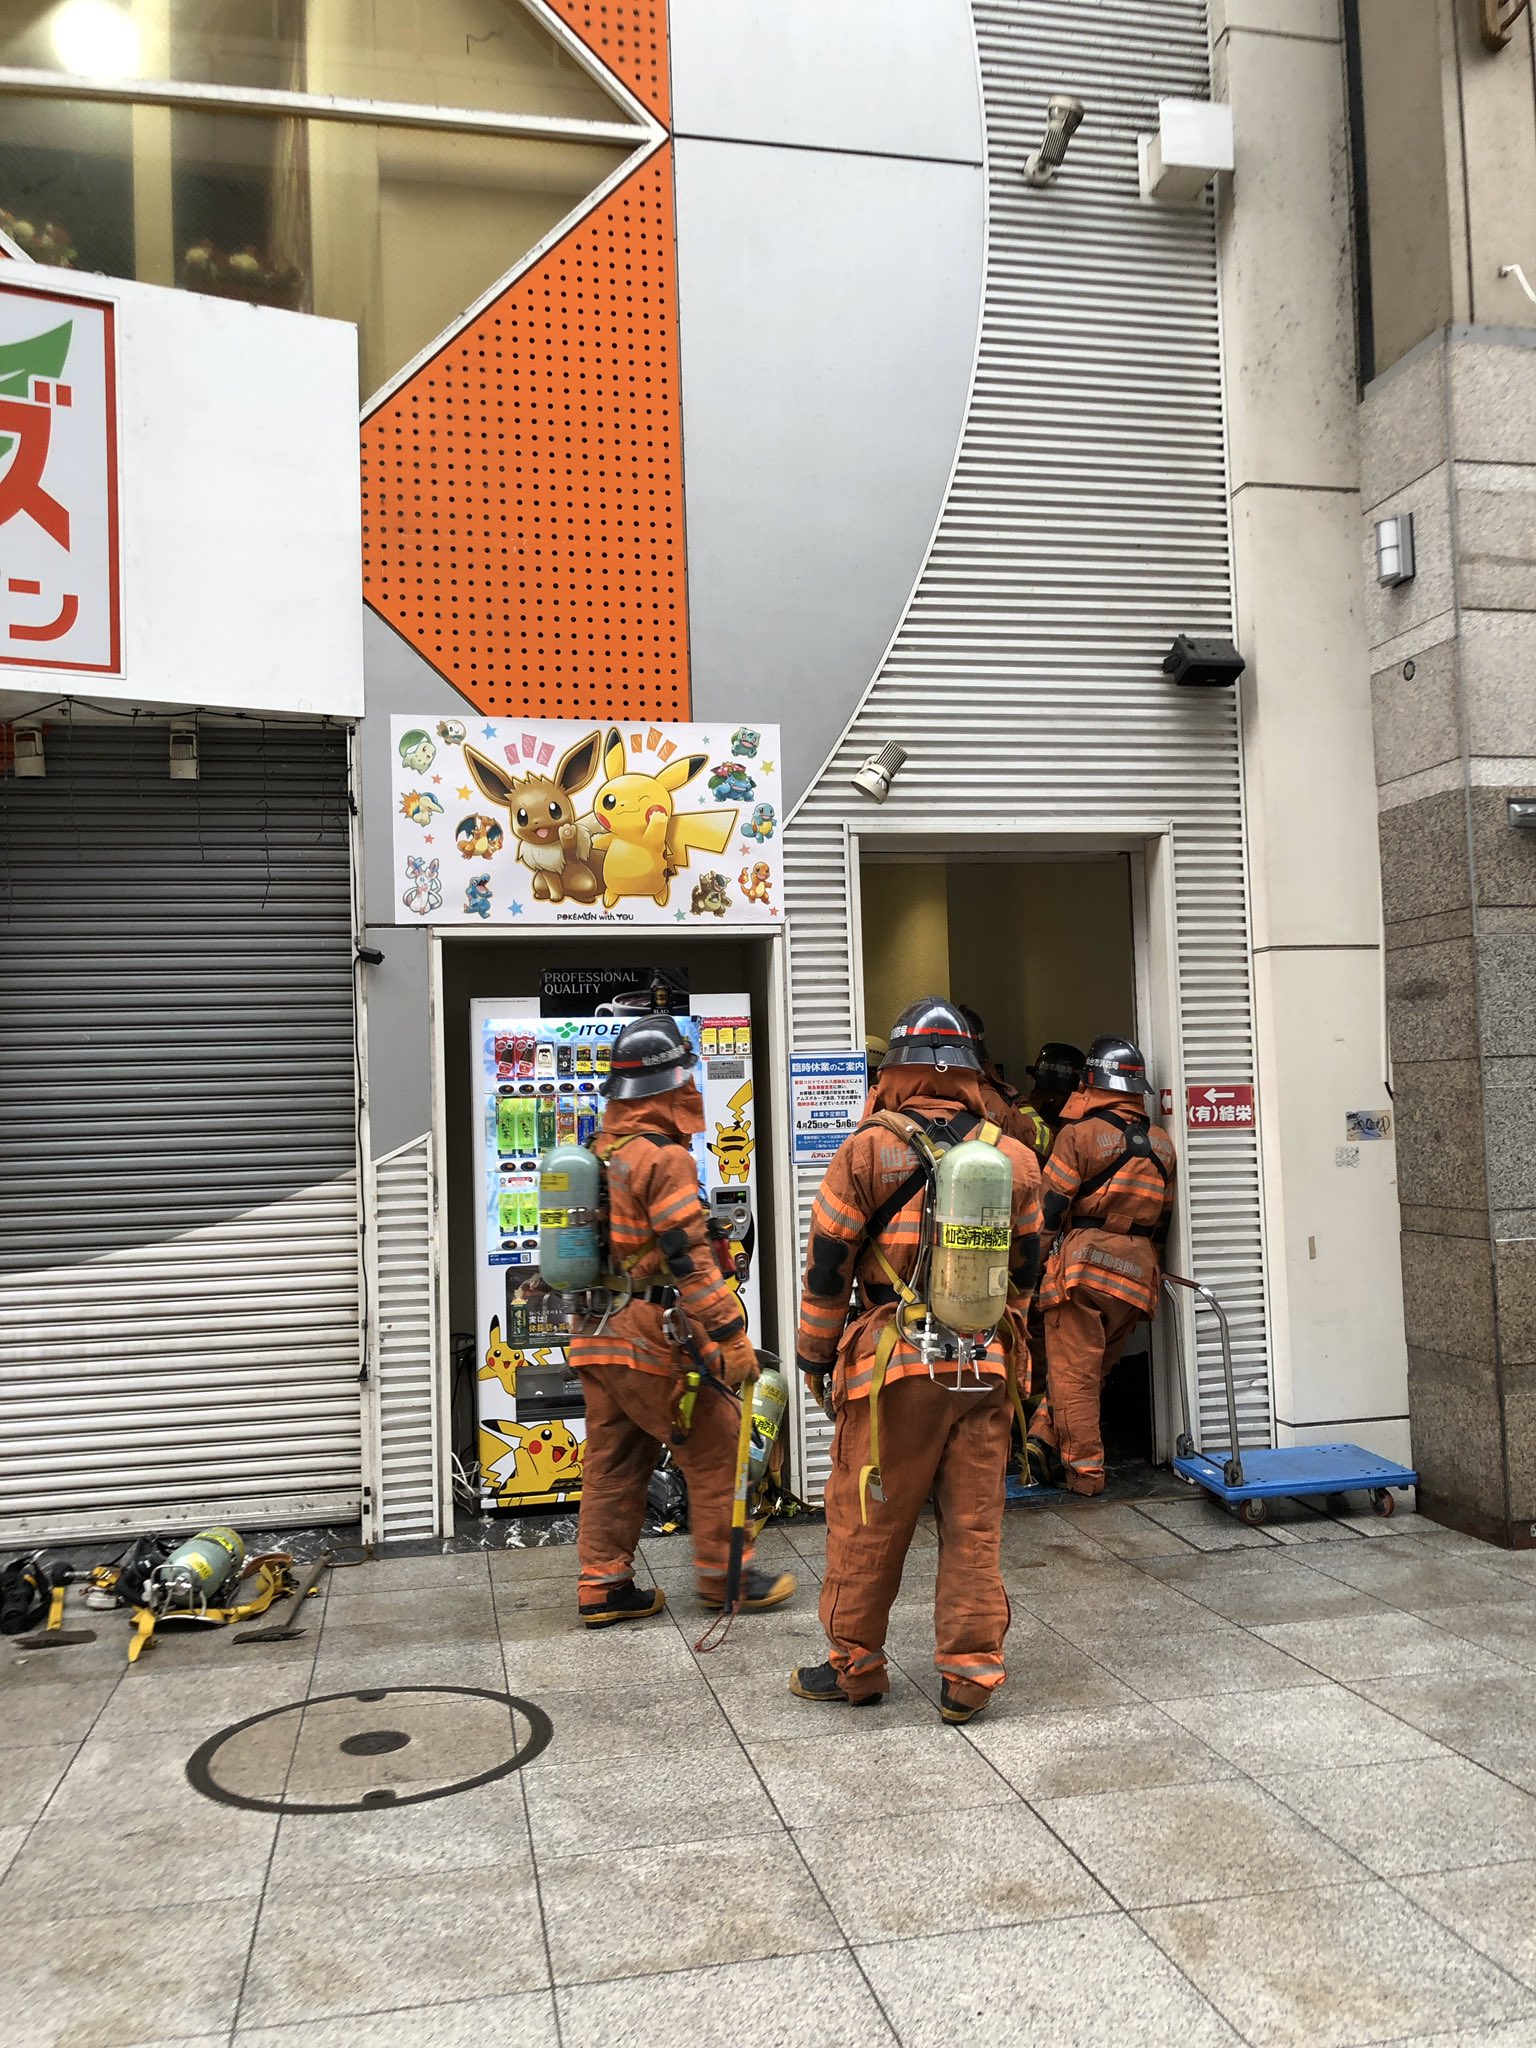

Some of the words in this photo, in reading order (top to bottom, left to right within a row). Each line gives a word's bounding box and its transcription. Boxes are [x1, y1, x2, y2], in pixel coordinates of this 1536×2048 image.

[598, 912, 615, 921] with
[616, 913, 634, 921] YOU
[544, 972, 638, 983] PROFESSIONAL
[544, 983, 600, 996] QUALITY
[578, 1024, 608, 1036] ITO
[791, 1061, 865, 1073] 臨時休業のご案内
[1189, 1105, 1252, 1122] (有)結栄
